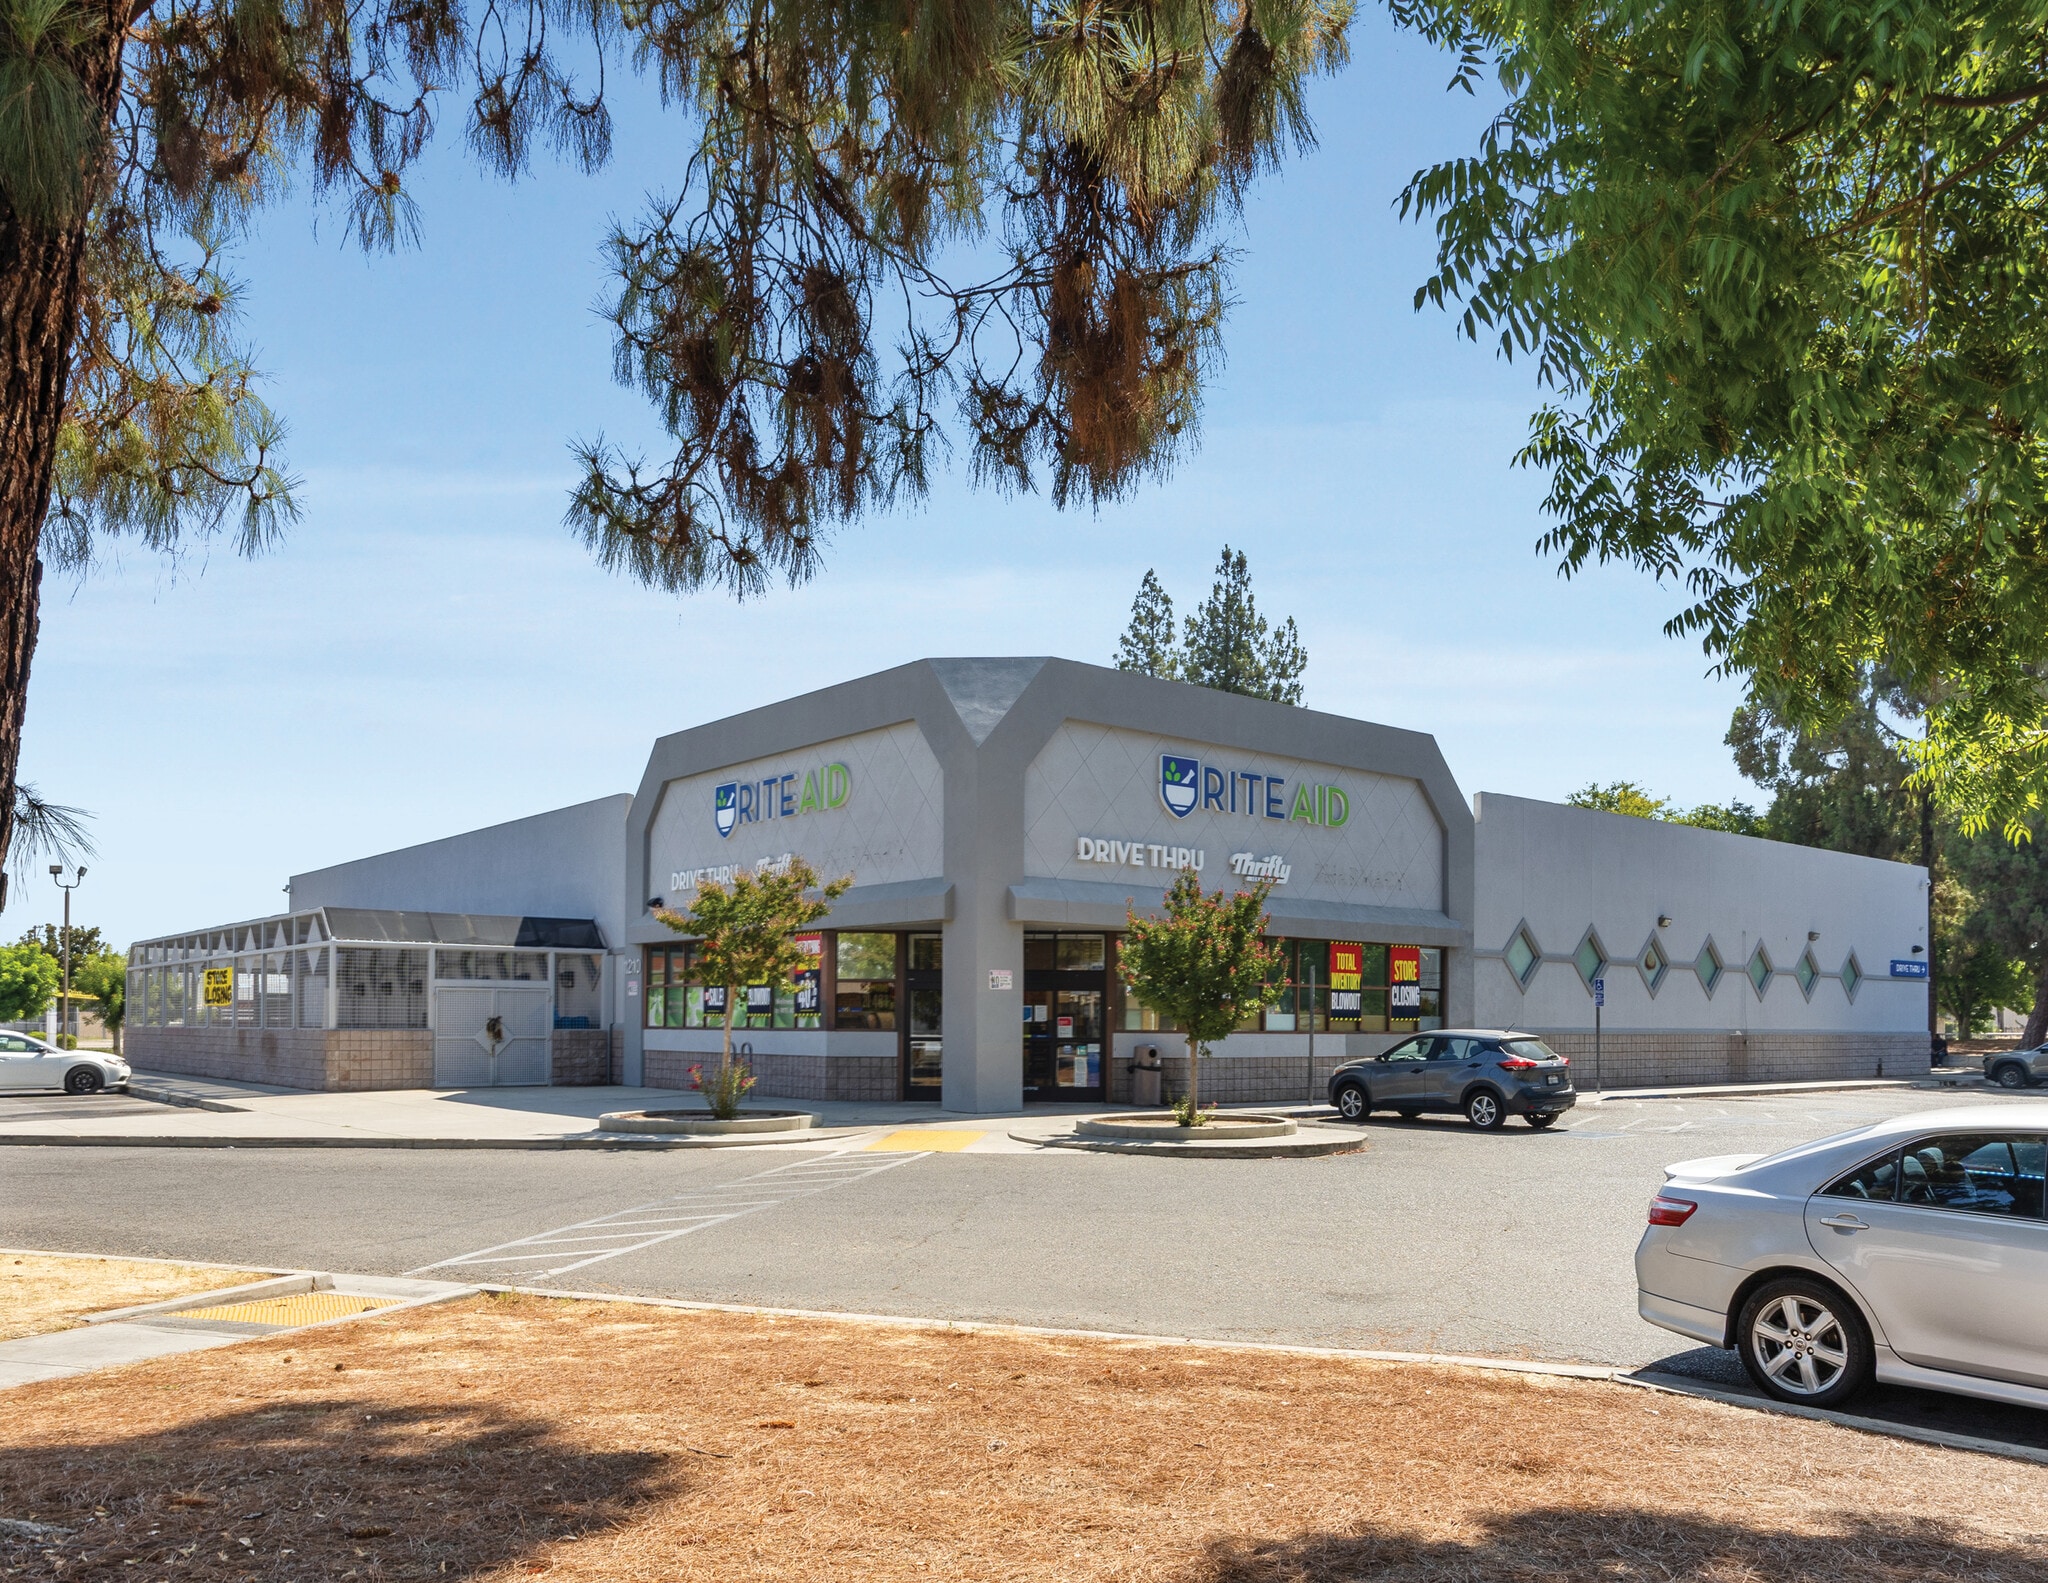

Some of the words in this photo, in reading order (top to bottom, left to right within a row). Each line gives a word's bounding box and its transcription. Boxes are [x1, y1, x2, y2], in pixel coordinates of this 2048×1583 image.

[740, 773, 798, 825] RITE
[800, 763, 850, 814] AID
[1201, 766, 1285, 819] RITE
[1290, 783, 1350, 828] AID
[1077, 837, 1144, 866] DRIVE
[1147, 844, 1204, 871] THRU
[1229, 852, 1291, 884] Thrifty
[1336, 952, 1357, 971] TOTAL
[1394, 960, 1417, 981] STORE
[1331, 972, 1361, 990] INVENTORY
[1331, 992, 1361, 1010] BLOWOUT
[1392, 985, 1420, 1006] CLOSING
